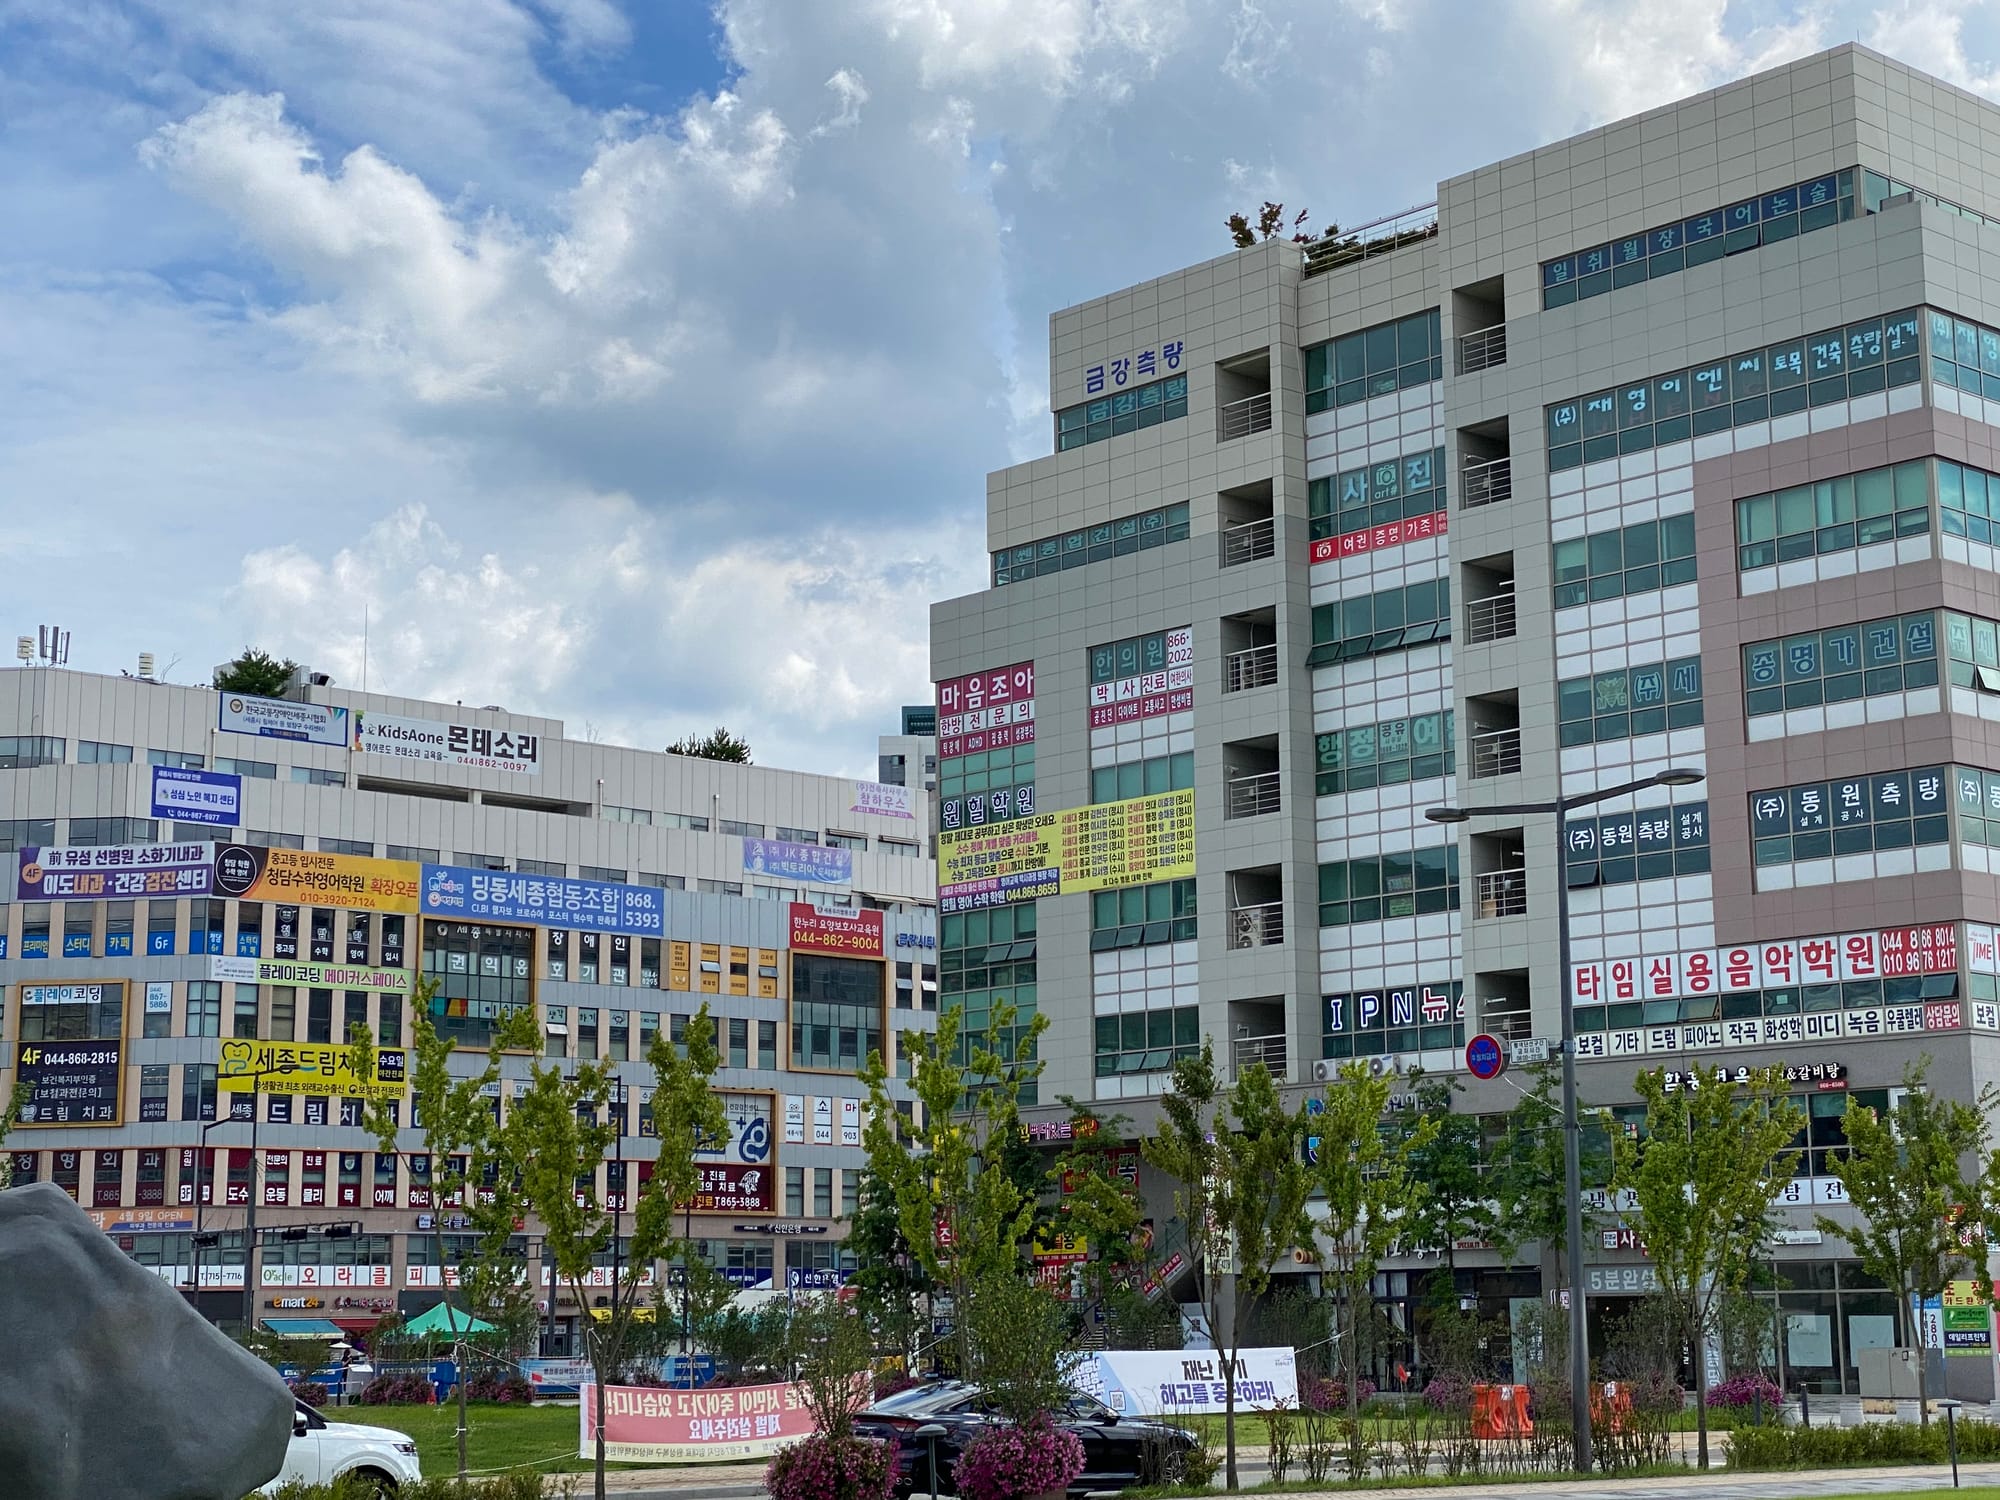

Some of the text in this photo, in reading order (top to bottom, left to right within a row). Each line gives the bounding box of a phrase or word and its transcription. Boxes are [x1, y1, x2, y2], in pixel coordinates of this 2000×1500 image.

[1086, 341, 1183, 394] 금강측량
[1555, 406, 1576, 427] (주)
[1774, 355, 1801, 375] 토목
[1812, 341, 1841, 369] 건축
[1850, 330, 1881, 359] 측량
[1886, 320, 1919, 350] 설계
[1089, 375, 1187, 421] 금강측량
[1344, 533, 1367, 552] 여권
[1375, 525, 1398, 546] 증명
[1407, 518, 1431, 537] 가족
[1096, 638, 1163, 677] 한의원
[1168, 648, 1193, 663] 2022
[942, 668, 1034, 710] 마음조아
[1142, 674, 1165, 693] 진료
[1633, 672, 1662, 702] (주)
[378, 724, 444, 745] KidsAone
[940, 716, 961, 736] 한방
[365, 742, 420, 758] 영어로도 몬테소리
[448, 725, 537, 763] 몬테소리
[170, 789, 234, 805] 성심 노인 복지 센터
[860, 792, 905, 808] 참하우스
[1756, 777, 1939, 821] (주) 동원측량
[1960, 778, 1981, 805] (주)
[974, 827, 1000, 839] 공부하고
[1035, 814, 1057, 828] 오세요.
[1681, 812, 1702, 825] 설계
[1800, 809, 1864, 827] 설계 공사
[1570, 820, 1670, 852] (주) 동원 측량
[1681, 825, 1703, 839] 공사
[48, 851, 62, 866] 前
[65, 845, 204, 866] 유성 선병원 소화기내과
[271, 852, 335, 870] 중고등 입시전문
[785, 847, 844, 867] JK 종합건설
[26, 868, 40, 878] 4F
[780, 861, 818, 876] 빅토리아
[267, 867, 364, 893] 청담수학영어학원
[370, 877, 418, 898] 확장오픈
[300, 892, 376, 908] 010-3920-7124
[471, 875, 619, 914] 딩동세종협동조합
[958, 895, 973, 909] 영어
[974, 892, 989, 907] 수학
[990, 889, 1006, 904] 학원
[516, 907, 544, 919] 브로슈어
[548, 911, 569, 922] 포스터
[573, 912, 593, 924] 현수막
[625, 911, 660, 929] 5393
[793, 917, 879, 937] 한누리 요양보호사교육원
[65, 936, 169, 951] 스터디 카페 6F
[793, 930, 879, 950] 044-862-9004
[1881, 926, 1955, 952] 044 866 8014
[275, 943, 399, 962] 중고등 수학 영어 입시
[1883, 948, 1956, 974] 010 9676 1217
[258, 963, 320, 983] 플레이코딩
[324, 968, 407, 989] 메이커스페이스
[1576, 935, 1875, 1000] 타임실용음악학원
[33, 987, 100, 1003] 플레이코딩
[1976, 1004, 1995, 1026] 보컬
[1578, 1003, 1961, 1055] 보컬 기타 드럼 피아노 작곡 화성학 미디 녹음 우쿨렐레 상담문의
[21, 1047, 118, 1065] 4F 044-868-2815
[256, 1047, 376, 1078] 세종드림치
[379, 1054, 404, 1067] 수요일
[41, 1074, 97, 1085] 보건복지부인증
[284, 1081, 345, 1094] 최초 외래교수출신
[82, 1105, 113, 1120] 치과
[816, 1130, 857, 1140] 044 903
[266, 1154, 323, 1166] 전문의 진료
[709, 1171, 727, 1181] 진료
[181, 1186, 192, 1200] 3F
[266, 1188, 286, 1202] 운동
[303, 1188, 323, 1203] 물리
[344, 1189, 355, 1204] 목
[374, 1189, 395, 1204] 어깨
[718, 1182, 736, 1192] 치료
[138, 1211, 153, 1221] 9일
[157, 1211, 183, 1220] OPEN
[774, 1223, 802, 1234] 신한은행
[273, 1296, 319, 1309] emart24
[1181, 1359, 1214, 1381] 재난
[1160, 1382, 1209, 1405] 해고를
